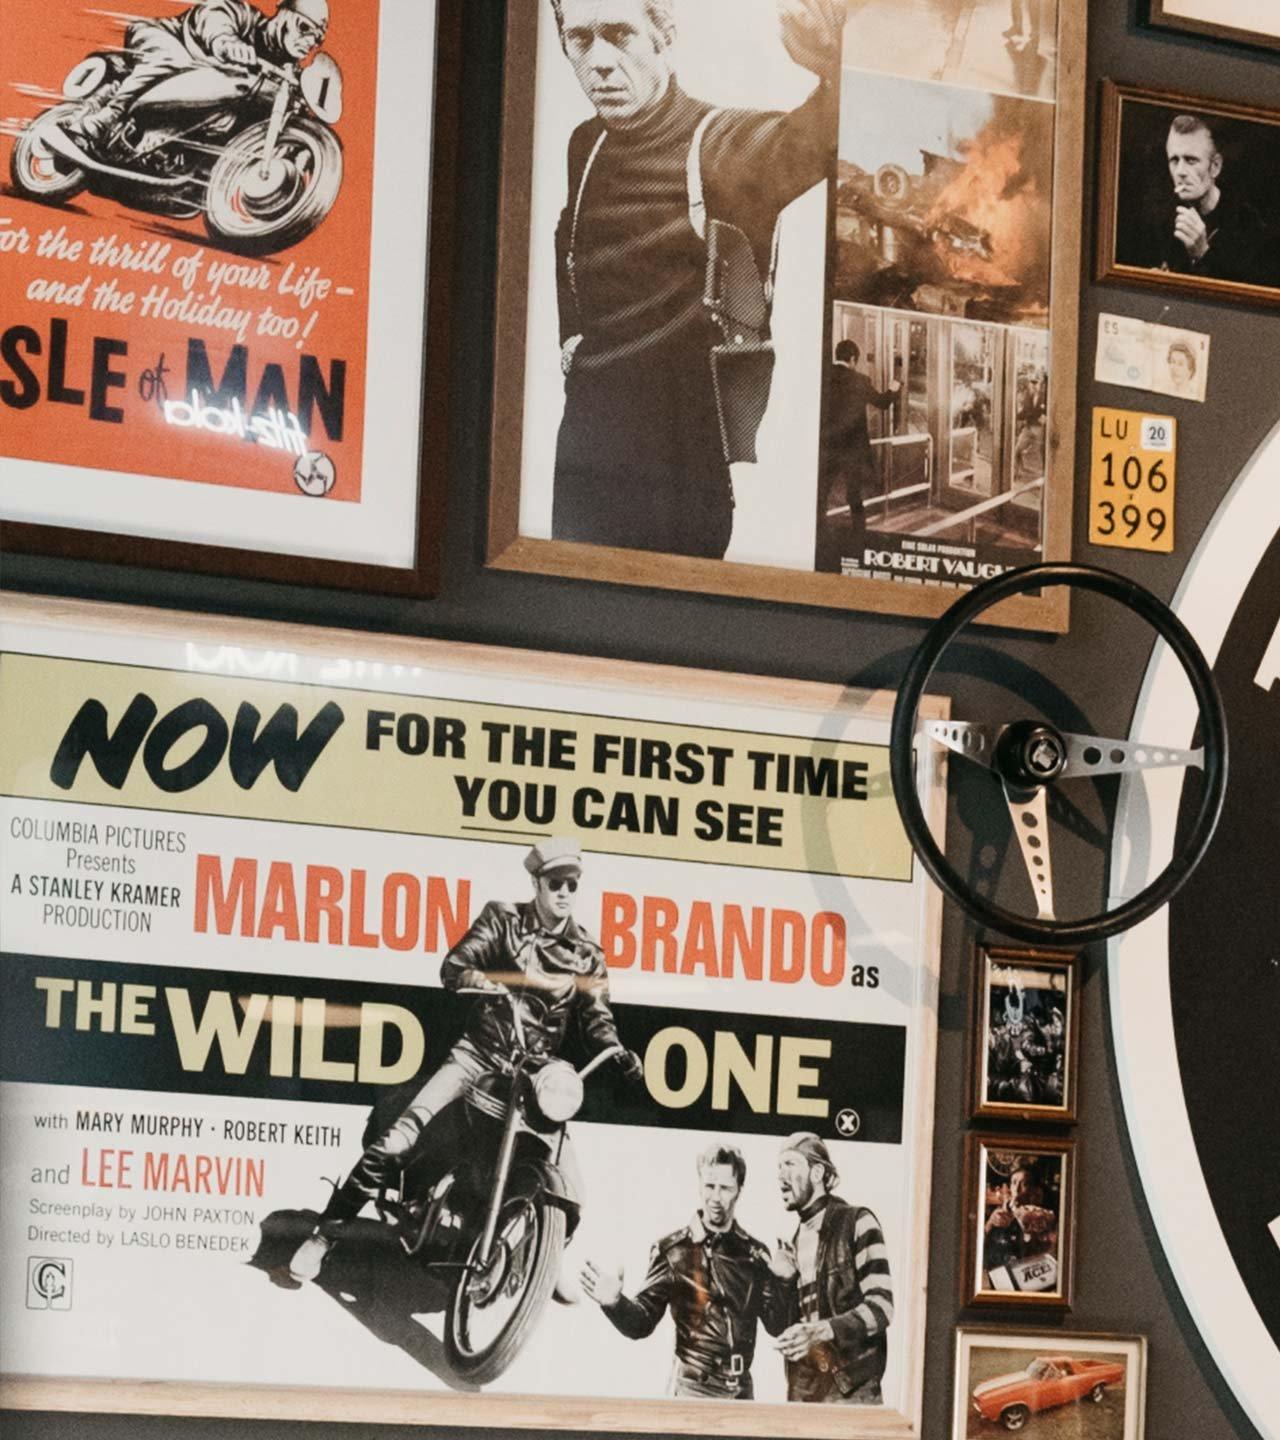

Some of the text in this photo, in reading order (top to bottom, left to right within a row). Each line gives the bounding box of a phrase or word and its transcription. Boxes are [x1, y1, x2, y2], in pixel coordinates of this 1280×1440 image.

[38, 226, 82, 262] the
[89, 233, 167, 275] thrill
[172, 249, 206, 291] of
[207, 262, 272, 297] your
[277, 261, 333, 308] Life
[26, 275, 319, 350] and the Holiday too!
[139, 352, 171, 413] of
[185, 337, 347, 442] MAN
[1100, 416, 1166, 441] LU 20
[1101, 452, 1168, 493] 106
[1097, 501, 1167, 542] 399
[864, 548, 941, 574] ROBERT
[50, 693, 869, 801] NOW FOR THE FIRST TIME
[454, 775, 785, 847] YOU CAN SEE
[10, 816, 187, 854] COLUMBIA PICTURES
[66, 847, 137, 875] Presents
[10, 873, 182, 909] A STANLEY KRAMER
[42, 903, 152, 933] PRODUCTION
[193, 853, 880, 989] MARLON BRANDO as
[34, 976, 832, 1120] THE WILD ONE
[34, 1110, 342, 1148] with MARY MURPHY ROBERT KEITH
[30, 1146, 267, 1198] and LEE MARVIN
[29, 1198, 256, 1227] Screenplay by JOHN PAXTON
[27, 1224, 250, 1253] Directed by LASLO BENEDEK
